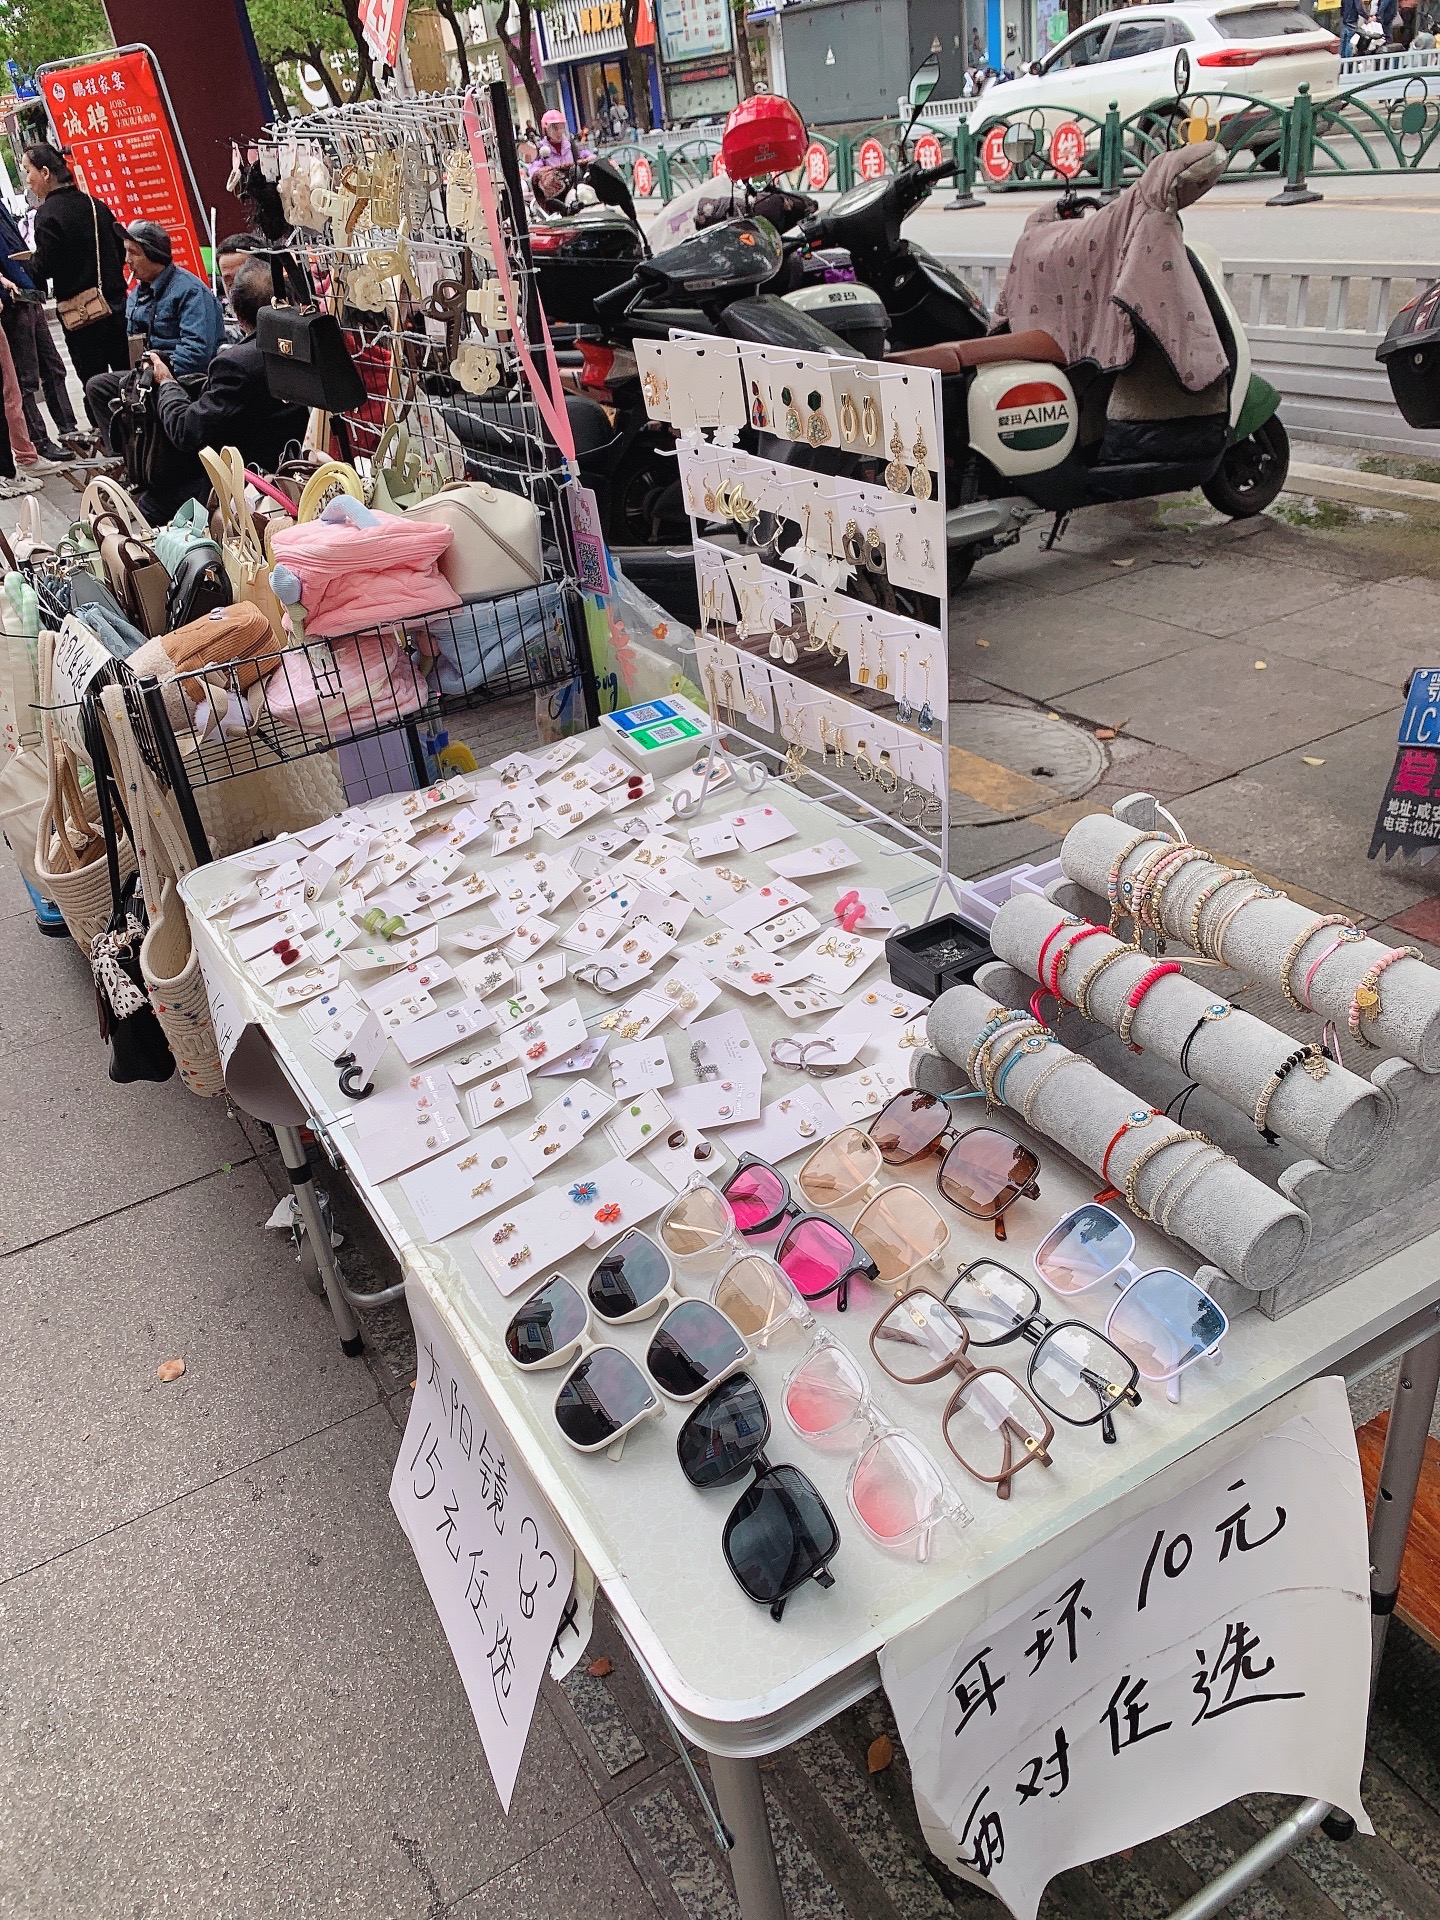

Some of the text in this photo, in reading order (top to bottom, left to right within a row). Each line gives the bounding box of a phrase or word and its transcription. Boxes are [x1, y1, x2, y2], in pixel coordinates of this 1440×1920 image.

[72, 71, 125, 98] 鹏程家宴
[109, 98, 127, 110] JOBS
[111, 105, 143, 119] WANTED
[62, 101, 110, 138] 诚聘
[1023, 403, 1069, 425] AIMA
[1383, 815, 1440, 840] 电话:13247
[423, 1342, 509, 1536] 太阳镜
[410, 1422, 516, 1728] 15元任选
